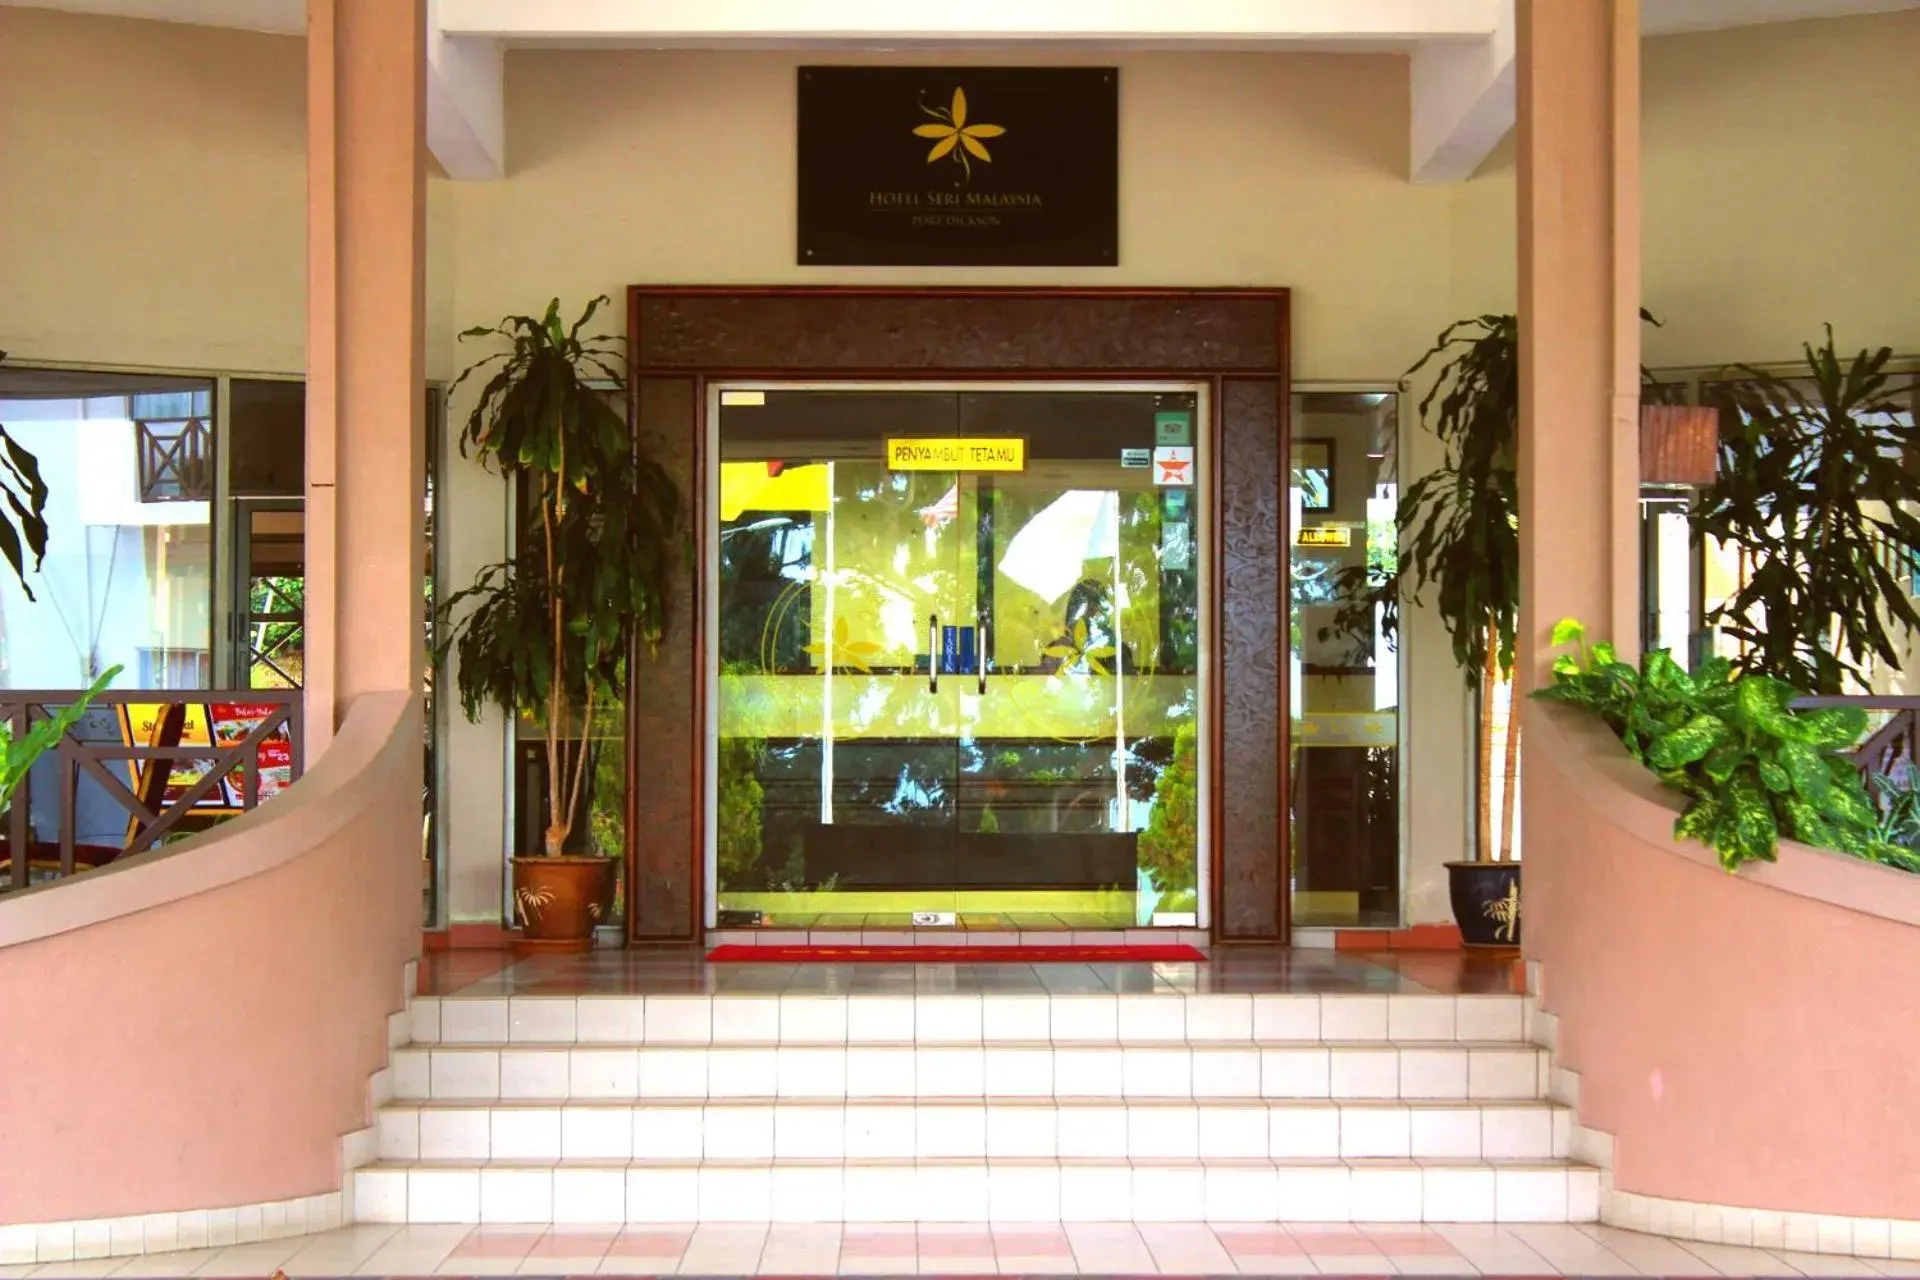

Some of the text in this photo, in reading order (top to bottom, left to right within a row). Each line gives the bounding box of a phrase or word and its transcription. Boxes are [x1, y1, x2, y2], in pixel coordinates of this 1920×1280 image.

[869, 191, 1042, 206] HOTEL SERI MALAYSIA
[912, 215, 1000, 226] PORT DICKSON
[895, 447, 1015, 462] PENYAMBUT TETAMU
